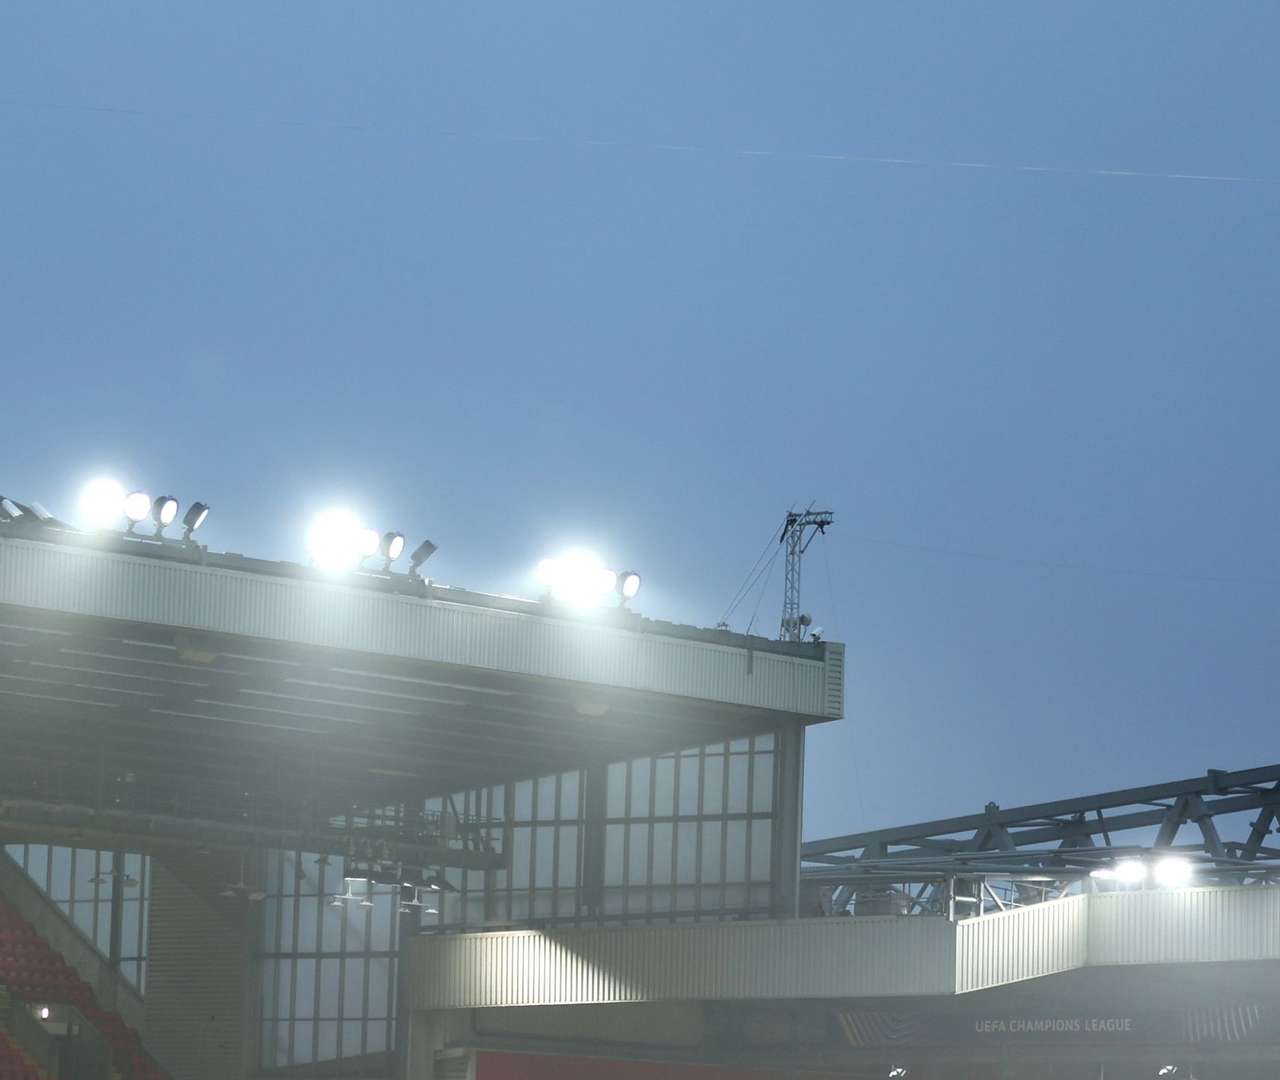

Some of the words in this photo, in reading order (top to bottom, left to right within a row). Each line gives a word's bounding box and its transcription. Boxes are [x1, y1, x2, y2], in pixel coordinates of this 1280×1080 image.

[975, 1020, 1007, 1033] UEFA
[1009, 1019, 1081, 1032] CHAMPIONS
[1084, 1018, 1132, 1032] LEAGUE
